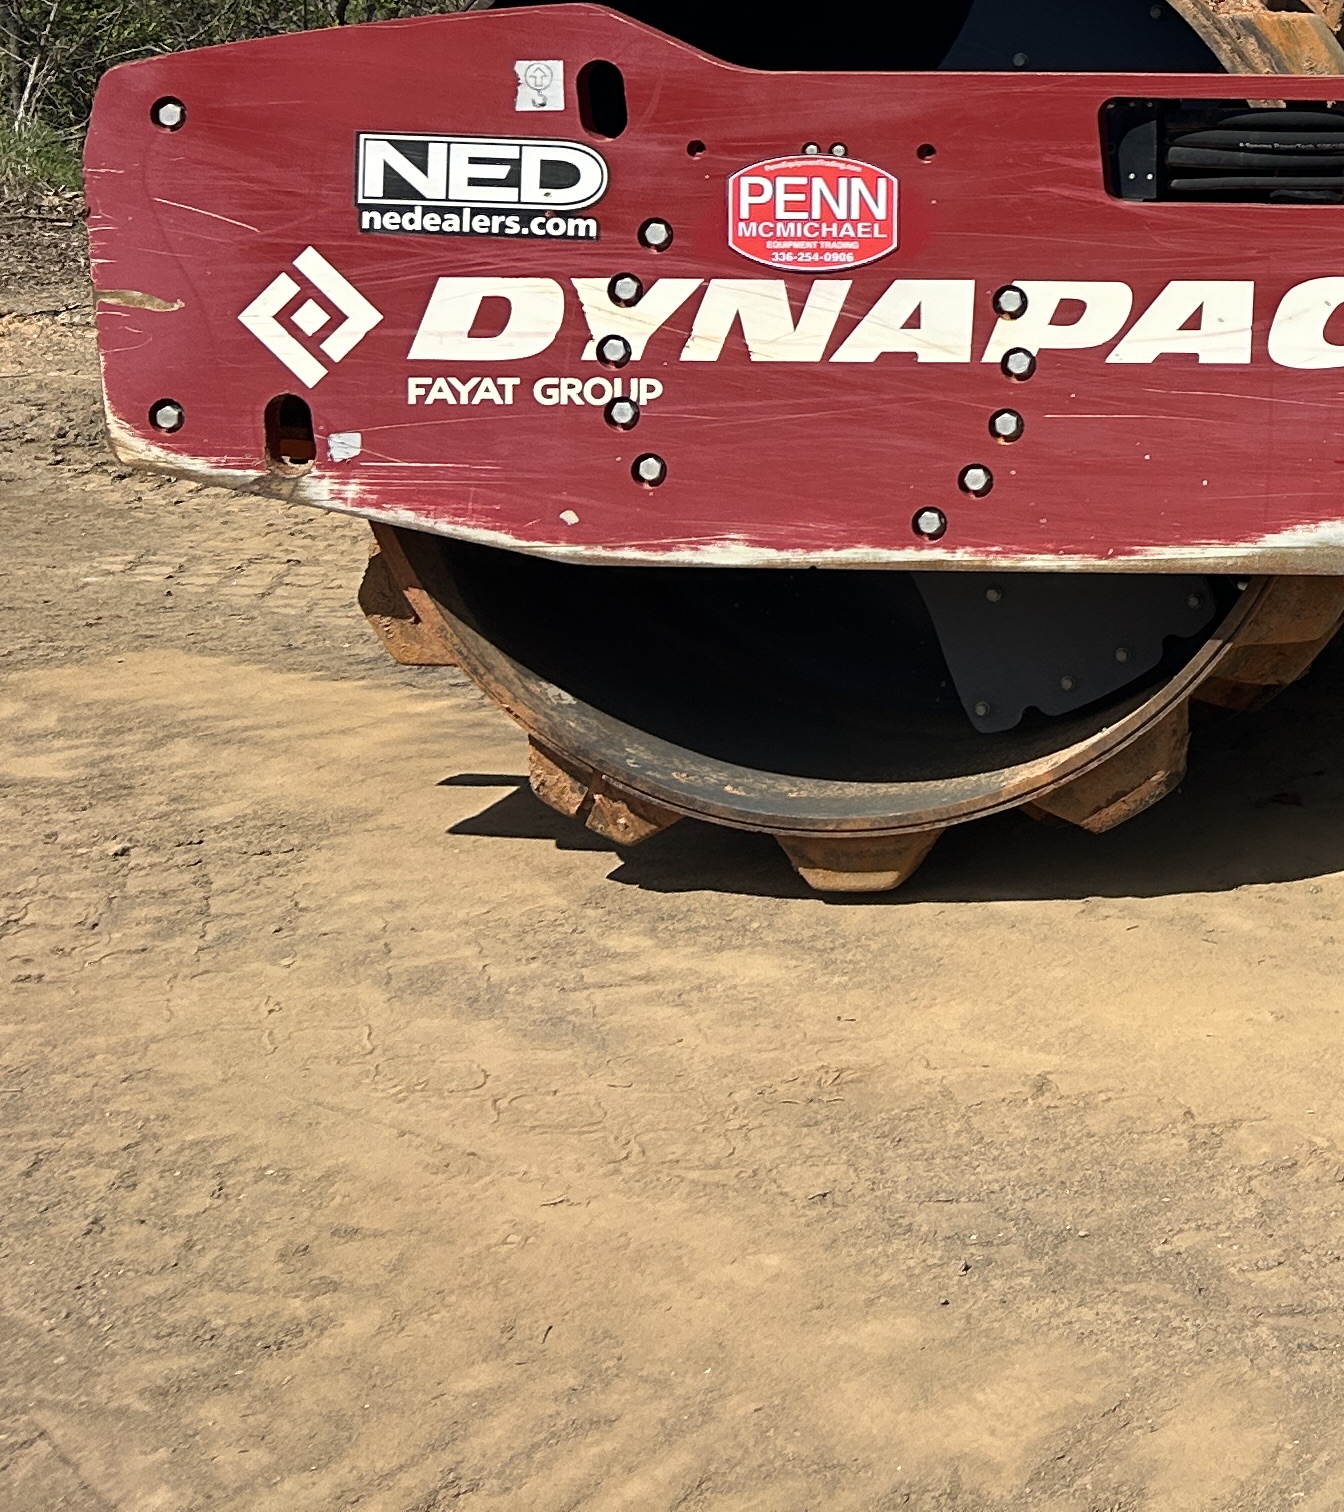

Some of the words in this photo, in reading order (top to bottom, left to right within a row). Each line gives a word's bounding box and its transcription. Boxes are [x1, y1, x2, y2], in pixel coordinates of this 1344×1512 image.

[362, 139, 605, 204] NED
[738, 176, 888, 220] PENN
[361, 205, 598, 237] nedealers.com
[737, 222, 888, 238] MCMICHAEL
[771, 251, 855, 263] 336-254-0906
[407, 377, 521, 405] FAYAT
[532, 376, 664, 406] GROUP
